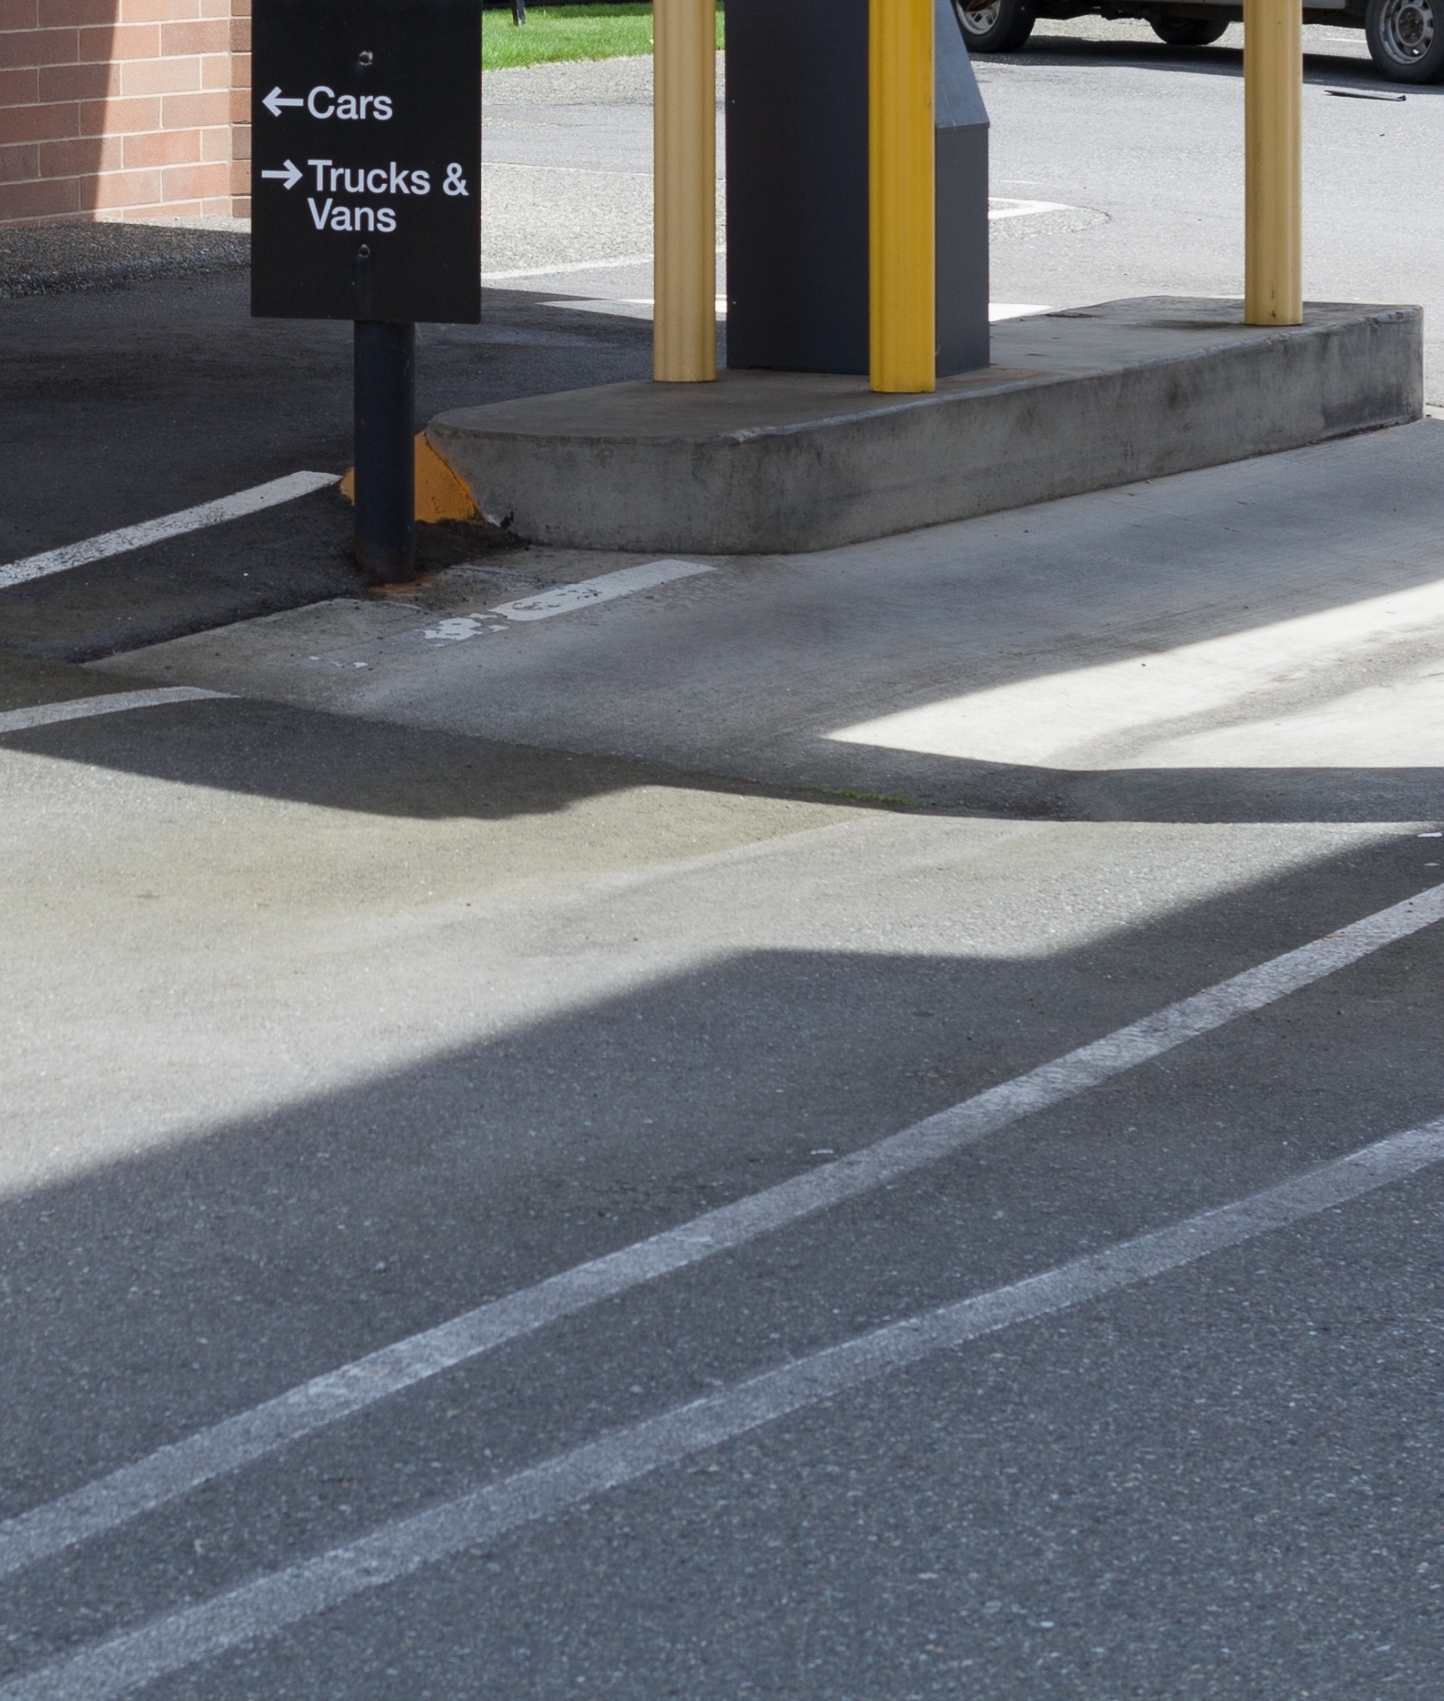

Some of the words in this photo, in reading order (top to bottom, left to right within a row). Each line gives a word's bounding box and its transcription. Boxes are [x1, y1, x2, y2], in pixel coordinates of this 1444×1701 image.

[307, 85, 393, 121] Cars
[307, 158, 431, 195] Trucks
[442, 162, 469, 196] &
[307, 197, 397, 232] Vans
